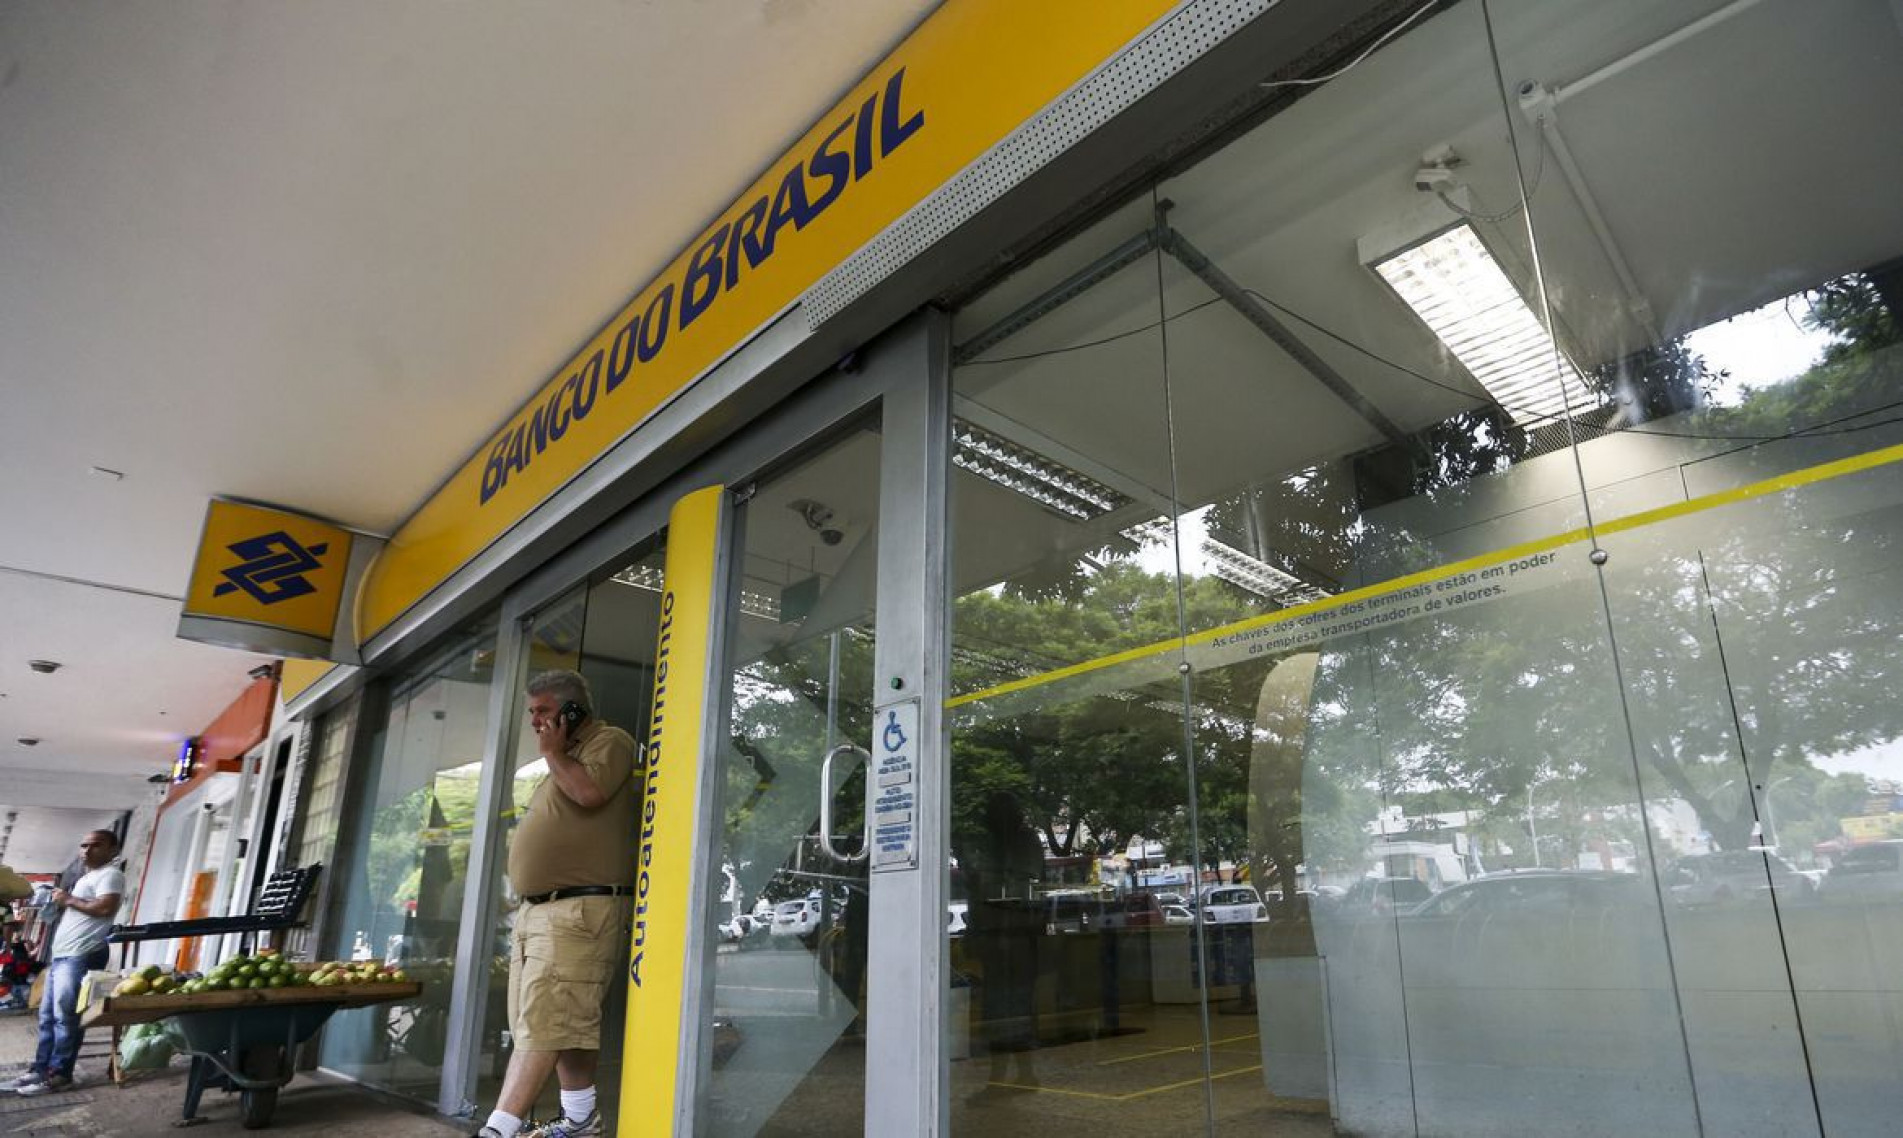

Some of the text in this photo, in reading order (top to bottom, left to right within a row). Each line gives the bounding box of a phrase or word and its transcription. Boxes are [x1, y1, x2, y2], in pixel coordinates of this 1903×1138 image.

[480, 65, 924, 507] BANCO DO BRASIL
[1212, 552, 1556, 648] As chaves dos cofres dos terminais estão em poder
[1249, 583, 1507, 655] da empresa transportadora de valores.
[630, 591, 675, 988] Autoatendimento
